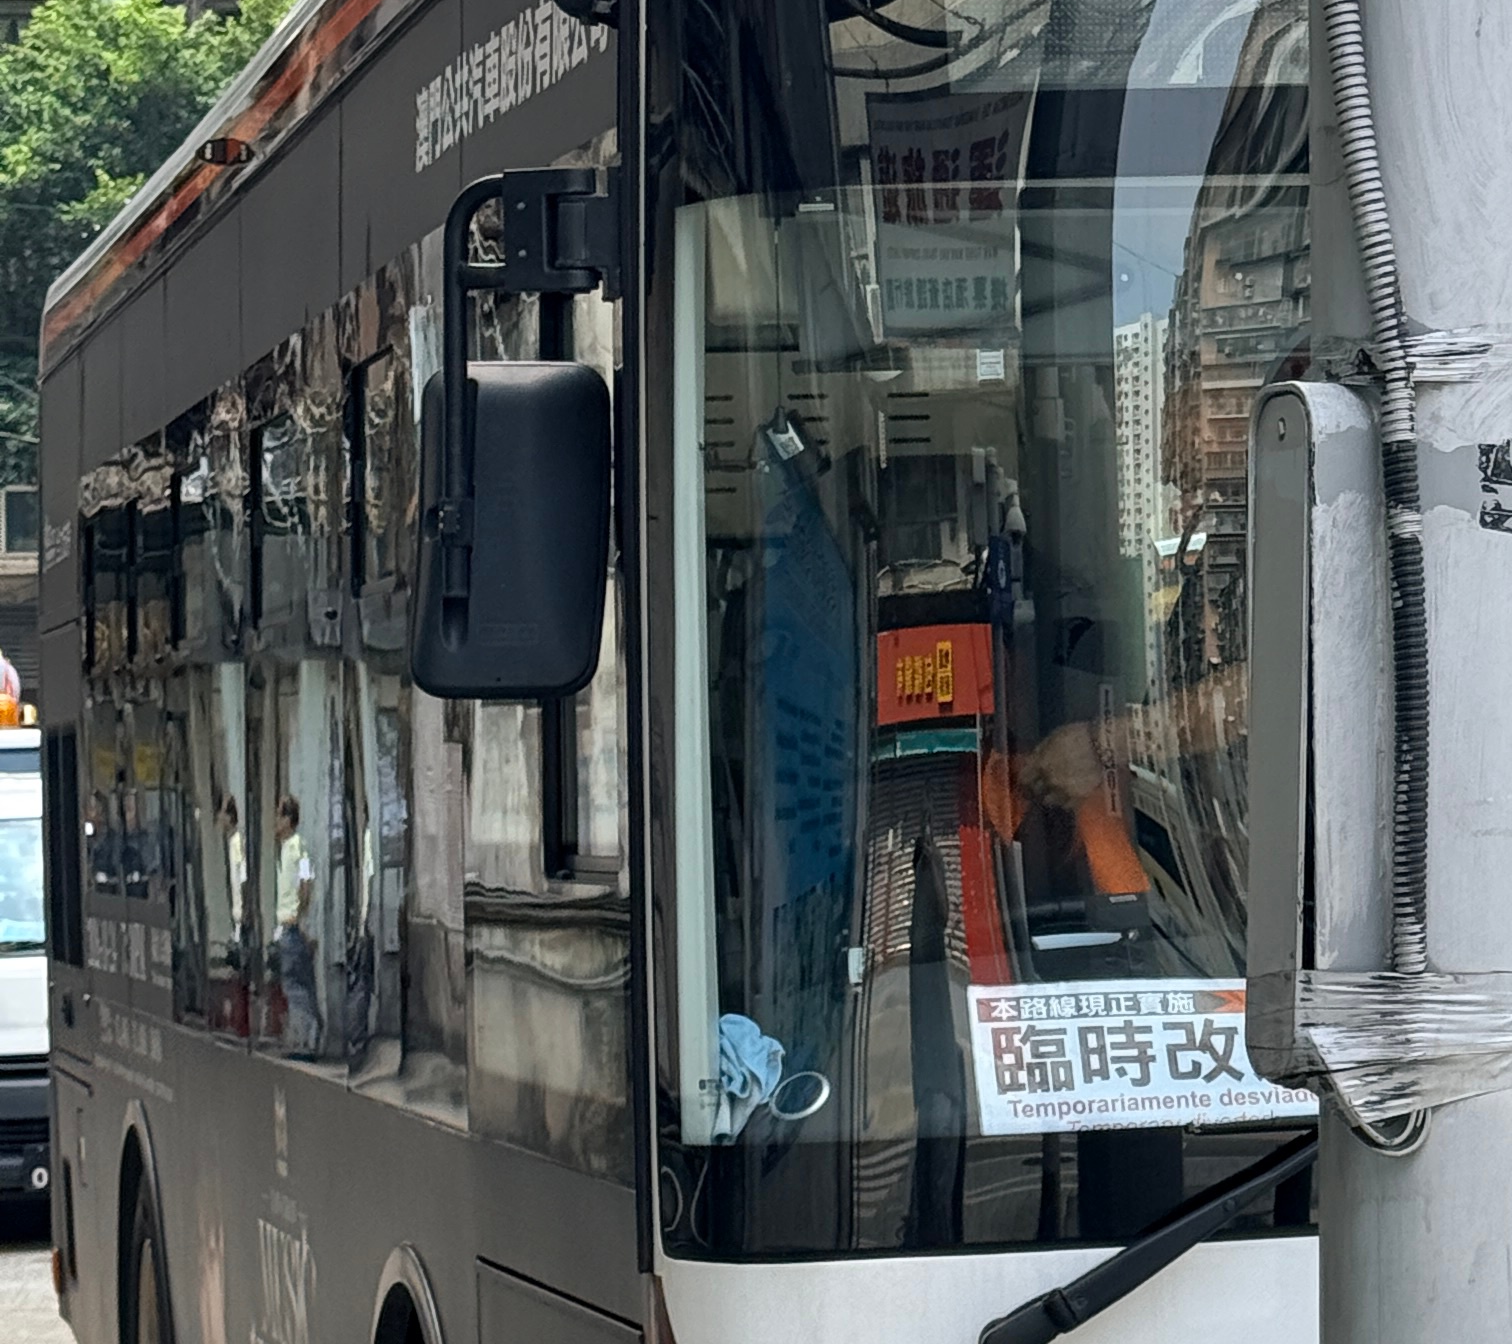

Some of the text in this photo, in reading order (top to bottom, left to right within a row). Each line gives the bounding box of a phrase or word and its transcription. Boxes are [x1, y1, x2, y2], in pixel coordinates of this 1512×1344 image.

[990, 991, 1197, 1019] 本路線現正實施
[990, 1018, 1266, 1095] 臨時改
[1008, 1097, 1213, 1119] Temporariamente
